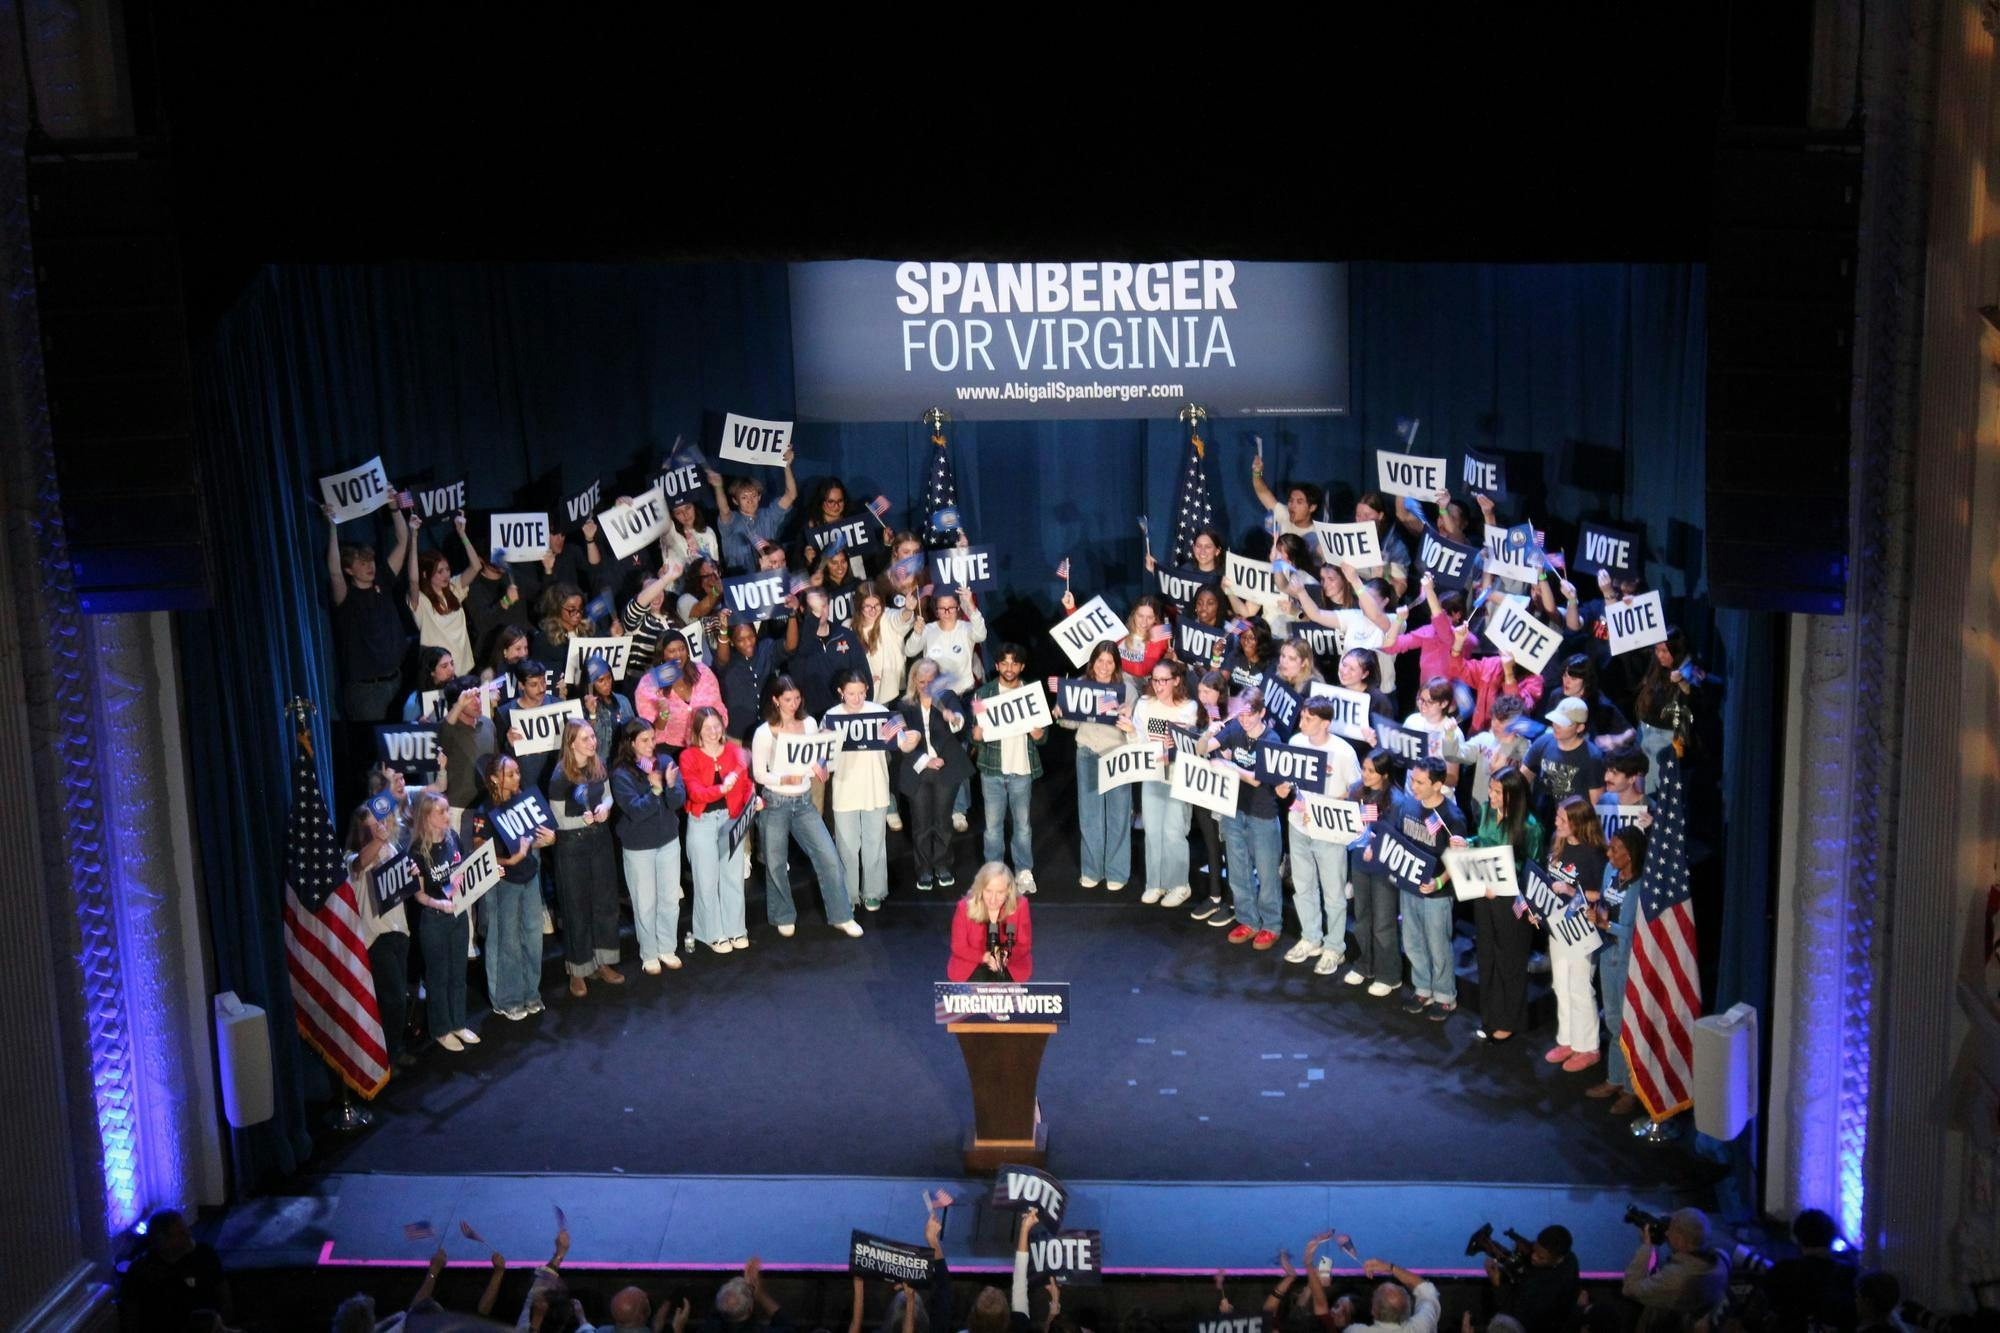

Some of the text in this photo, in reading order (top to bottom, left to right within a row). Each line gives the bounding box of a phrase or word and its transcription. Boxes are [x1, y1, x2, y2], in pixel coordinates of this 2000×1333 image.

[895, 260, 1238, 315] SPANBERGER
[902, 316, 1236, 371] FOR VIRGINIA
[956, 381, 1184, 402] www.AbigailSpanberger.com
[734, 423, 784, 453] VOTE
[332, 468, 383, 507] VOTE
[653, 464, 701, 498] VOTE
[1387, 461, 1437, 490] VOTE
[1464, 452, 1498, 492] VOTE
[419, 481, 465, 518] VOTE
[566, 479, 601, 522] VOTE
[500, 521, 545, 548] VOTE
[610, 499, 663, 540] VOTE
[1321, 530, 1371, 556] VOTE
[1421, 533, 1468, 577] VOTE
[1586, 531, 1630, 569] VOTE
[937, 553, 990, 585] VOTE
[730, 577, 786, 612] VOTE
[1063, 606, 1115, 650] VOTE
[1500, 608, 1550, 659] VOTE
[1612, 602, 1658, 638] VOTE
[987, 692, 1040, 727] VOTE
[1264, 677, 1298, 727] VOTE
[1331, 697, 1361, 726] OTE
[384, 732, 438, 761] VOTE
[787, 739, 836, 764] VOTE
[1378, 723, 1422, 761] VOTE
[1106, 750, 1157, 778] VOTE
[1184, 762, 1230, 800] VOTE
[1264, 747, 1319, 782] VOTE
[497, 796, 548, 841] VOTE
[732, 799, 756, 844] VOTE
[1311, 803, 1357, 834] VOTE
[459, 851, 493, 898] VOTE
[1379, 833, 1426, 886] VOTE
[1456, 854, 1507, 883] VOTE
[377, 855, 414, 901] VOTE
[943, 995, 1063, 1013] VIRGINIA VOTES
[1007, 1172, 1063, 1221] VOTE
[855, 1243, 929, 1270] SPANBERGER
[855, 1255, 927, 1280] FOR VIRGINIA
[1030, 1239, 1092, 1273] VOTE
